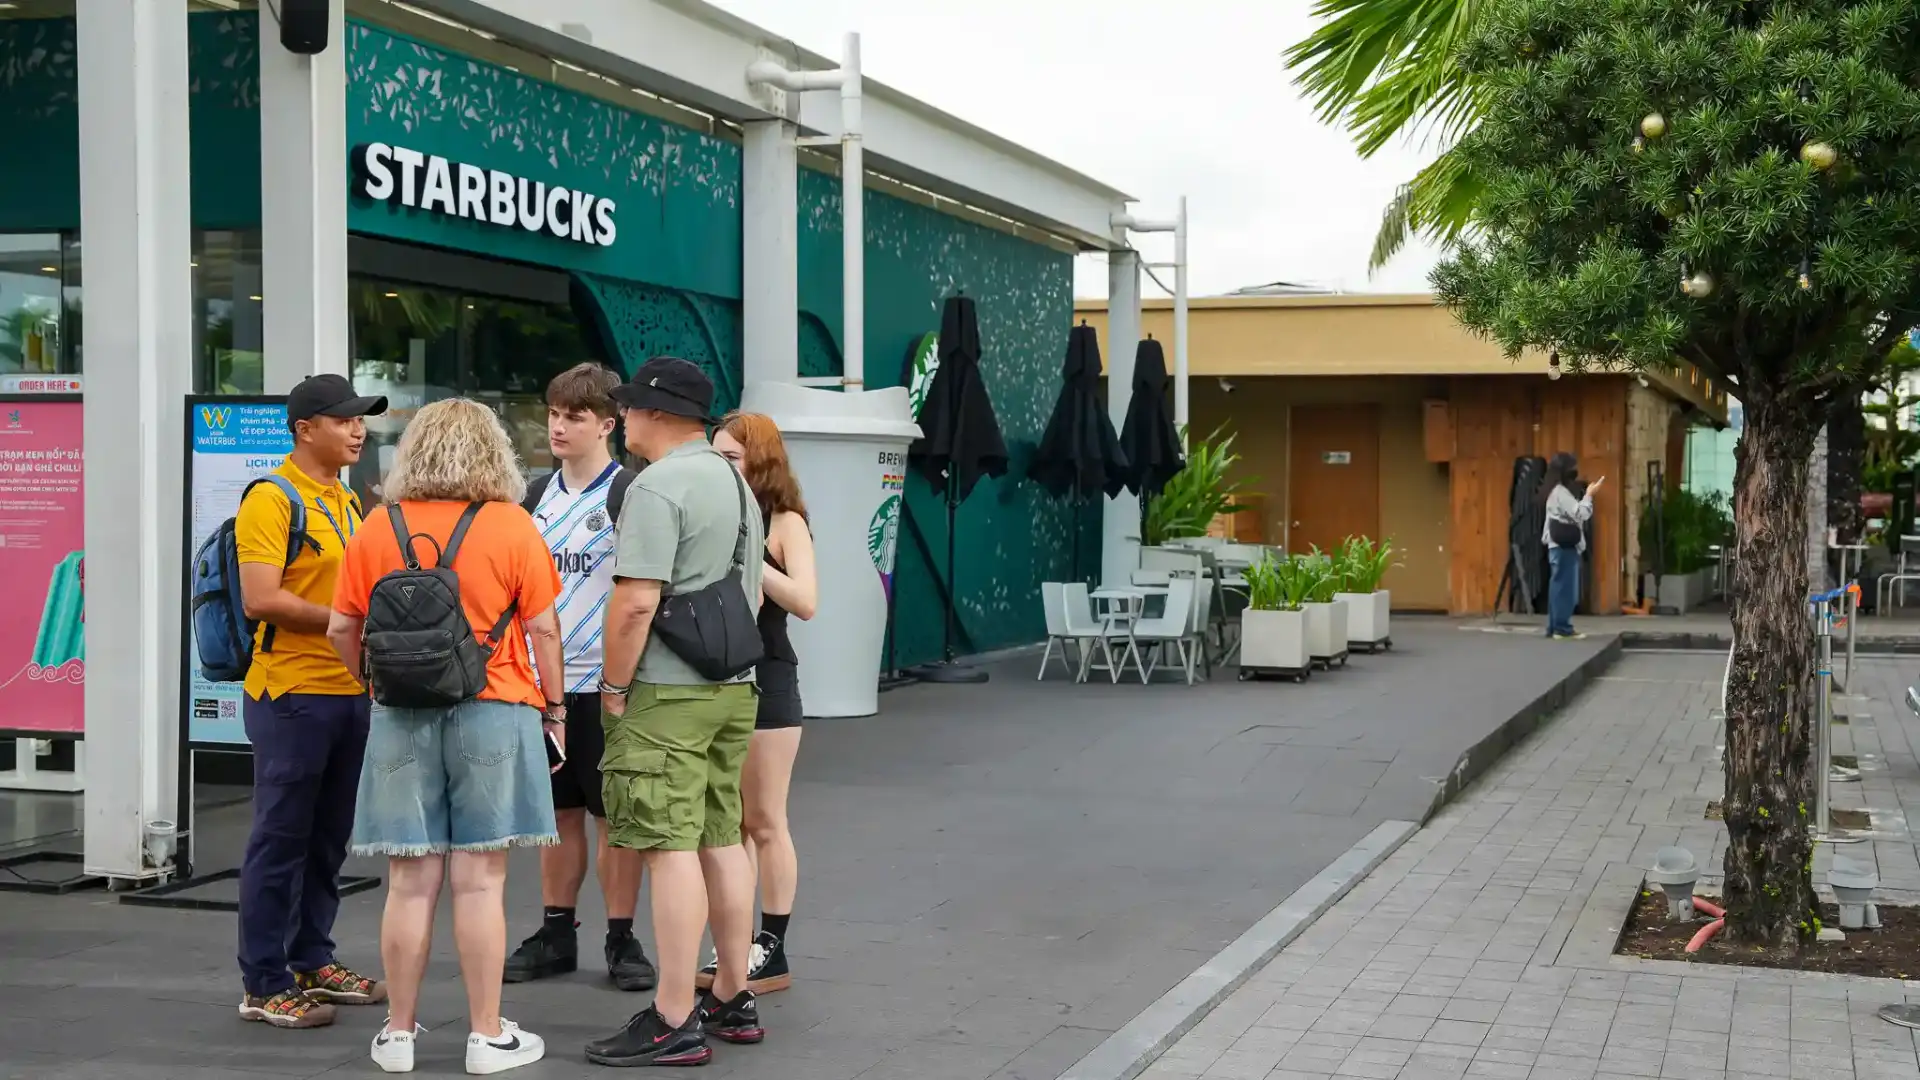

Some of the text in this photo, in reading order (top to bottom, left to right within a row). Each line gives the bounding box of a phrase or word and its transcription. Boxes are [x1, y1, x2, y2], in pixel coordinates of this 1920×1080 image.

[365, 142, 616, 246] STARBUCKS
[19, 380, 67, 391] ORDER HERE
[267, 426, 288, 435] SÔNG
[197, 437, 237, 446] WATERBUS
[0, 450, 24, 461] TRẠM
[25, 450, 45, 460] KEM
[67, 449, 81, 460] ĐÃ
[0, 461, 13, 472] ỜI
[15, 463, 33, 475] BẠN
[245, 459, 269, 470] LỊCH
